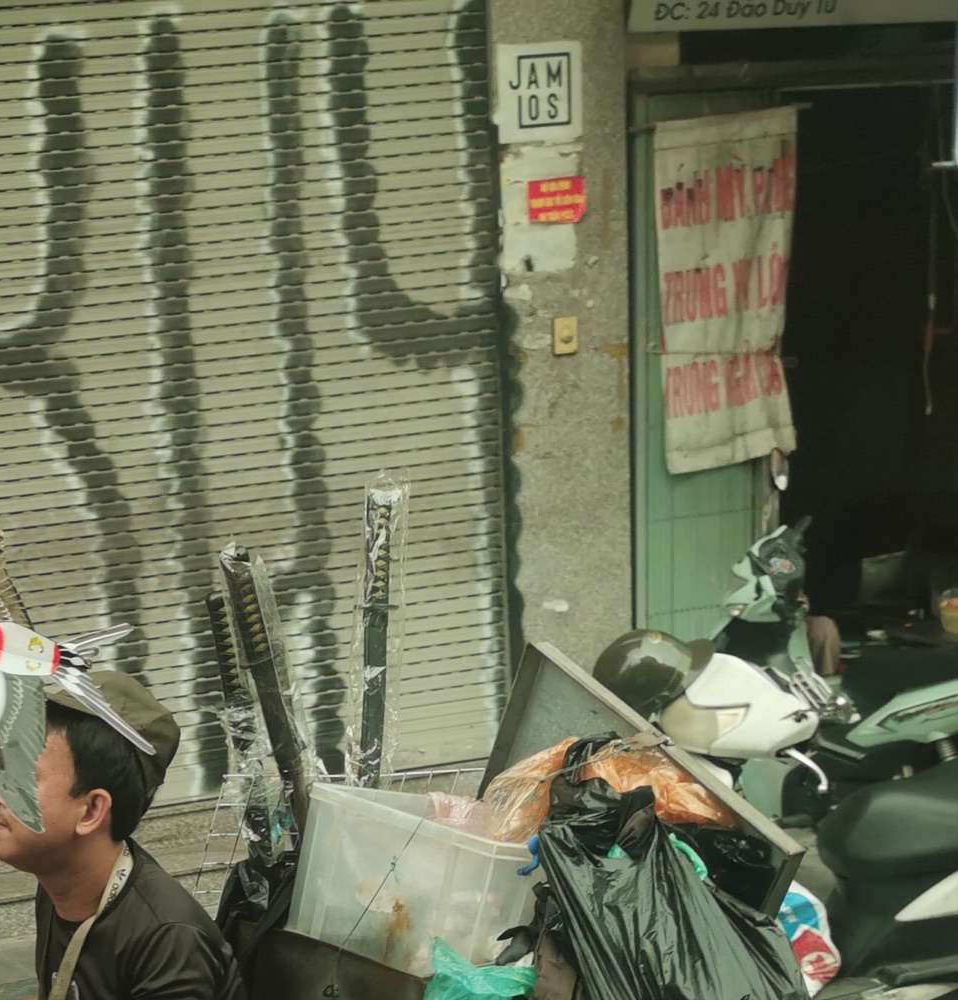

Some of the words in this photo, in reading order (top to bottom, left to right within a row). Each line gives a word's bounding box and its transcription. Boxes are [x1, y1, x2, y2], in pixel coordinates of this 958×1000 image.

[654, 2, 690, 20] ĐC:
[696, 1, 720, 19] 24
[773, 0, 811, 19] Duy
[508, 58, 563, 90] JAM
